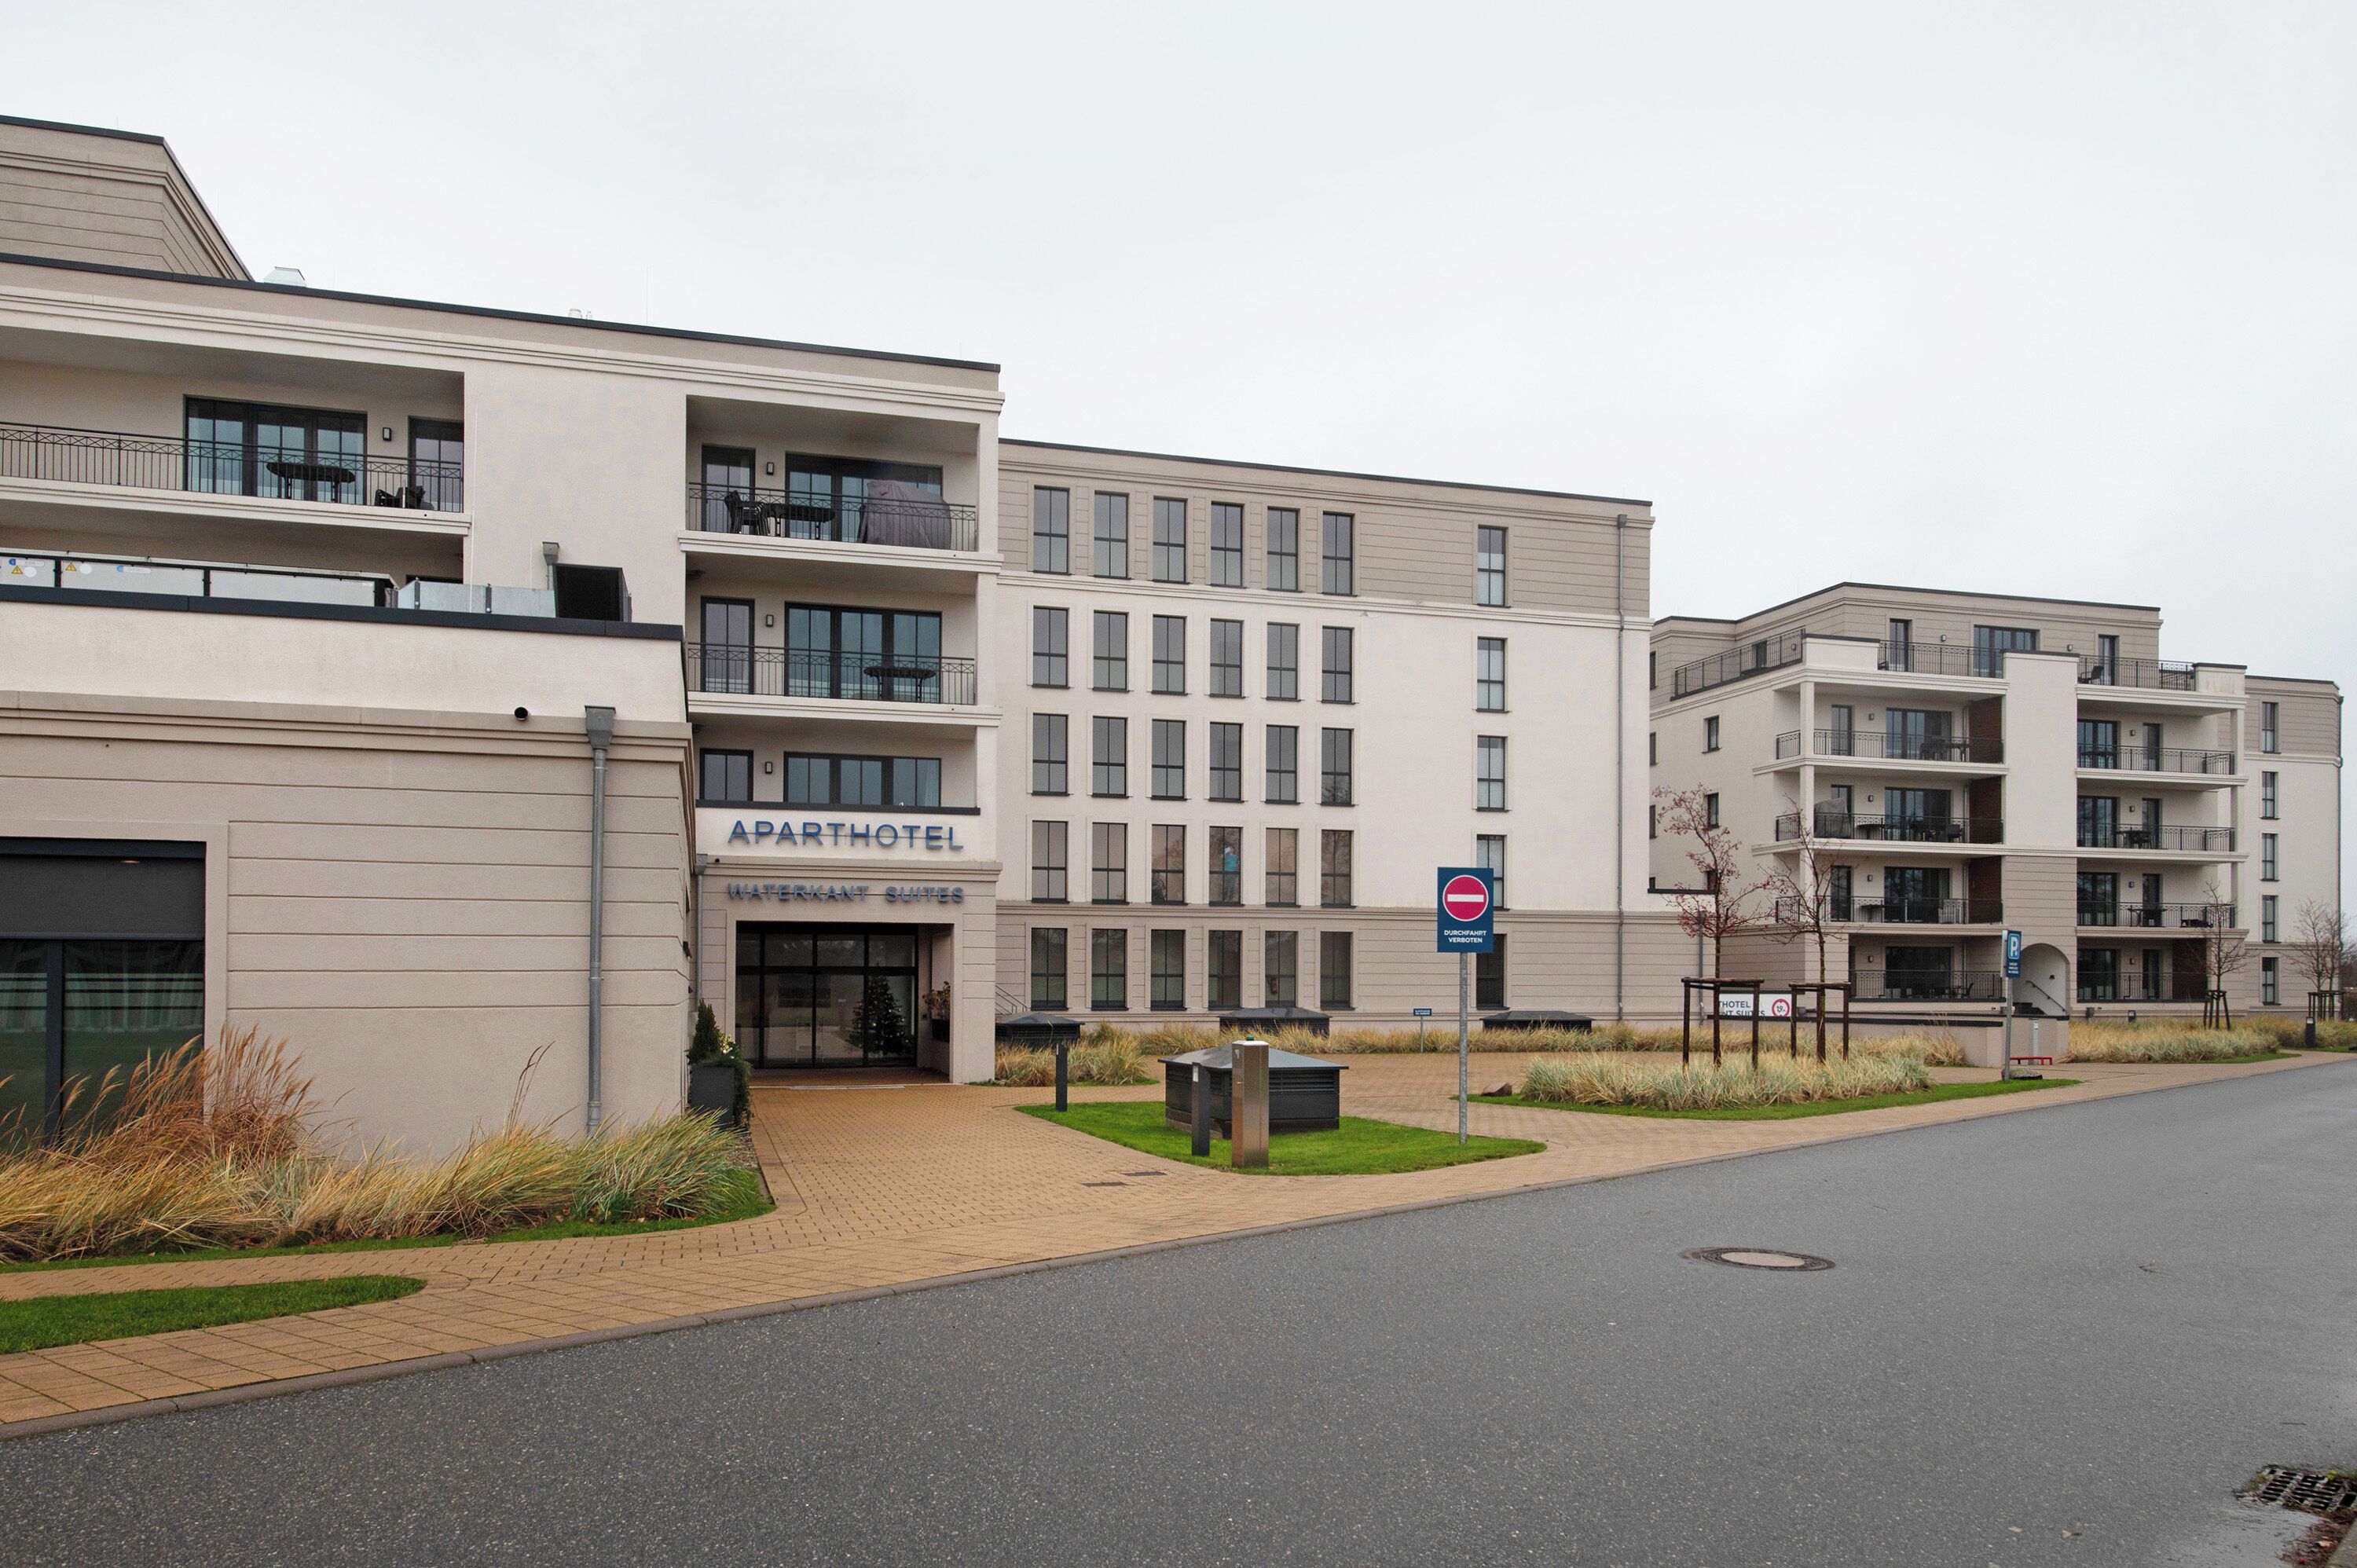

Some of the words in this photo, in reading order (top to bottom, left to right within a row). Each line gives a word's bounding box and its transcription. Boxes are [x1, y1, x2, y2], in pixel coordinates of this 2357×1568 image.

[728, 820, 964, 850] APARTHOTEL
[728, 882, 870, 902] WATERKANT
[885, 885, 965, 903] SUITES
